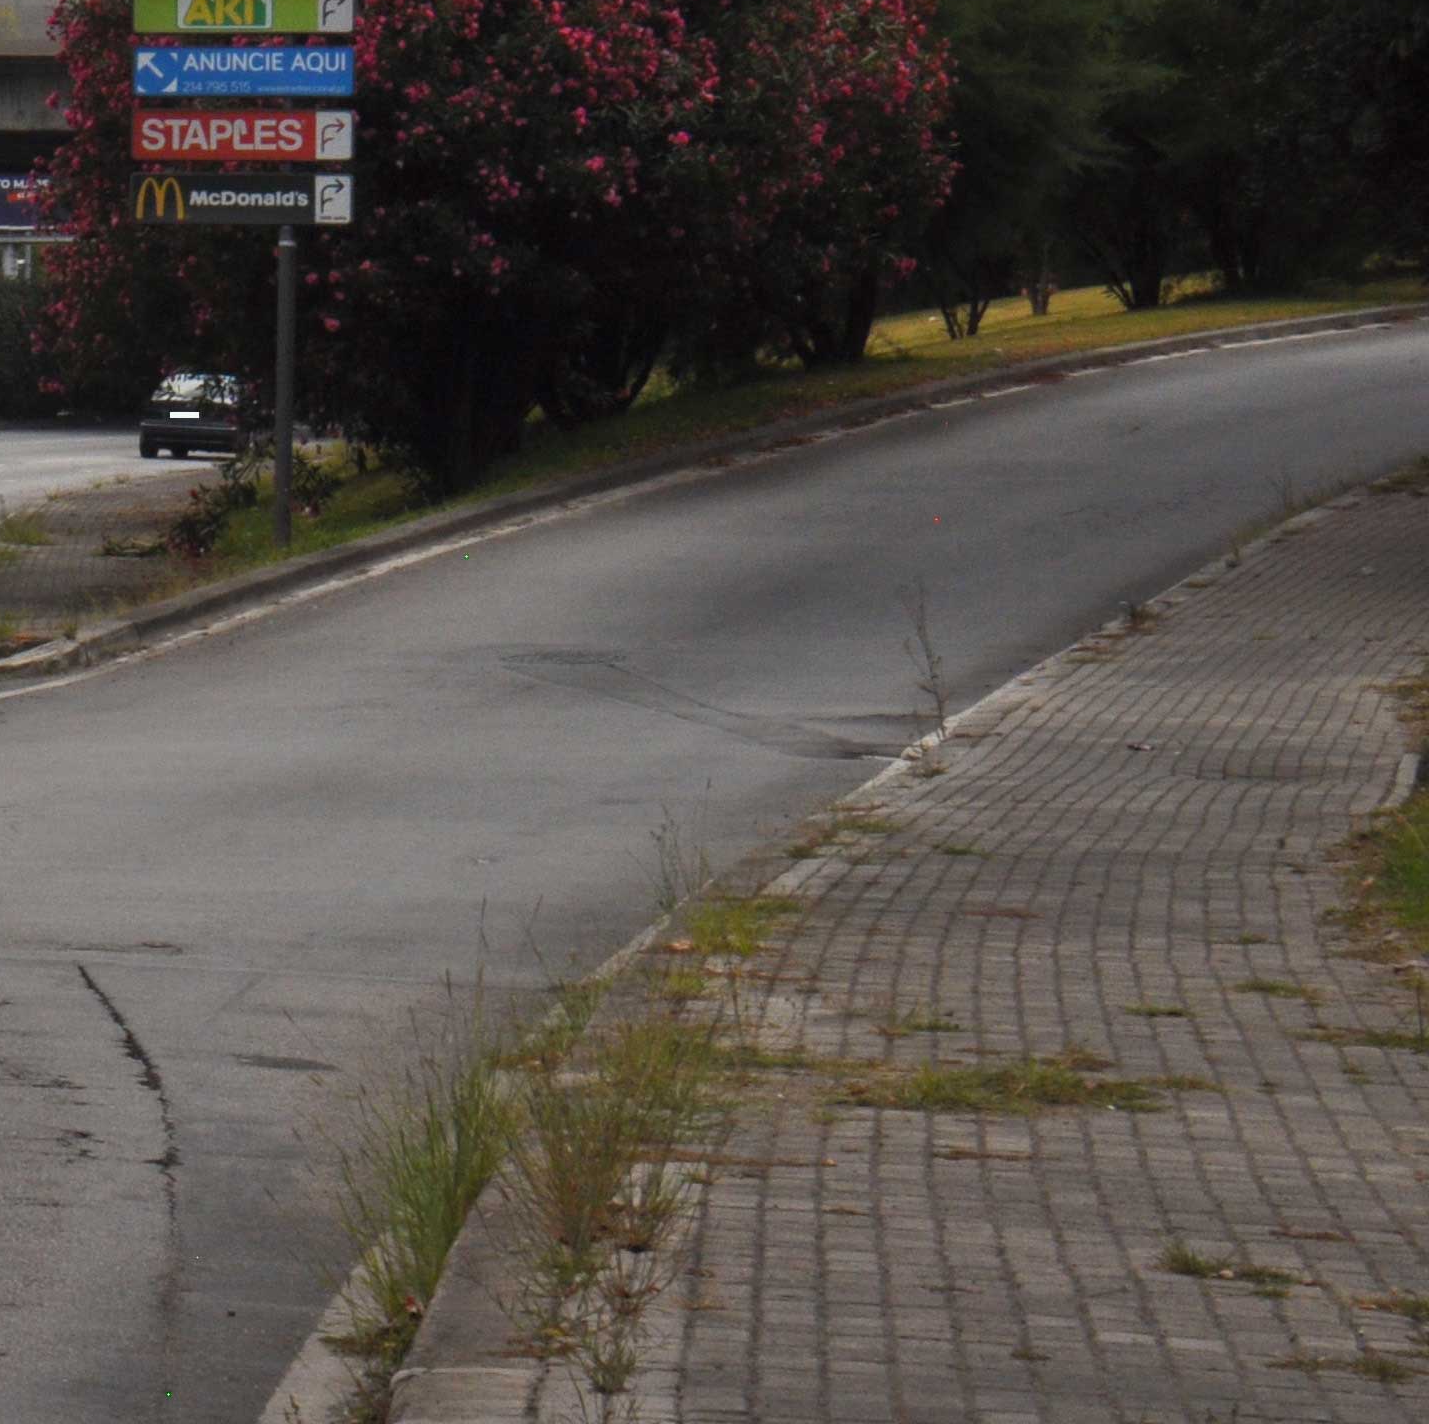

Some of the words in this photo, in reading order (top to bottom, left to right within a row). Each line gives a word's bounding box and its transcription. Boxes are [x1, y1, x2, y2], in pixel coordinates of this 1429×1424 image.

[183, 52, 284, 71] ANUNCIE
[291, 52, 346, 73] AQUI
[141, 118, 304, 151] STAPLES
[189, 189, 309, 208] McDonald's
